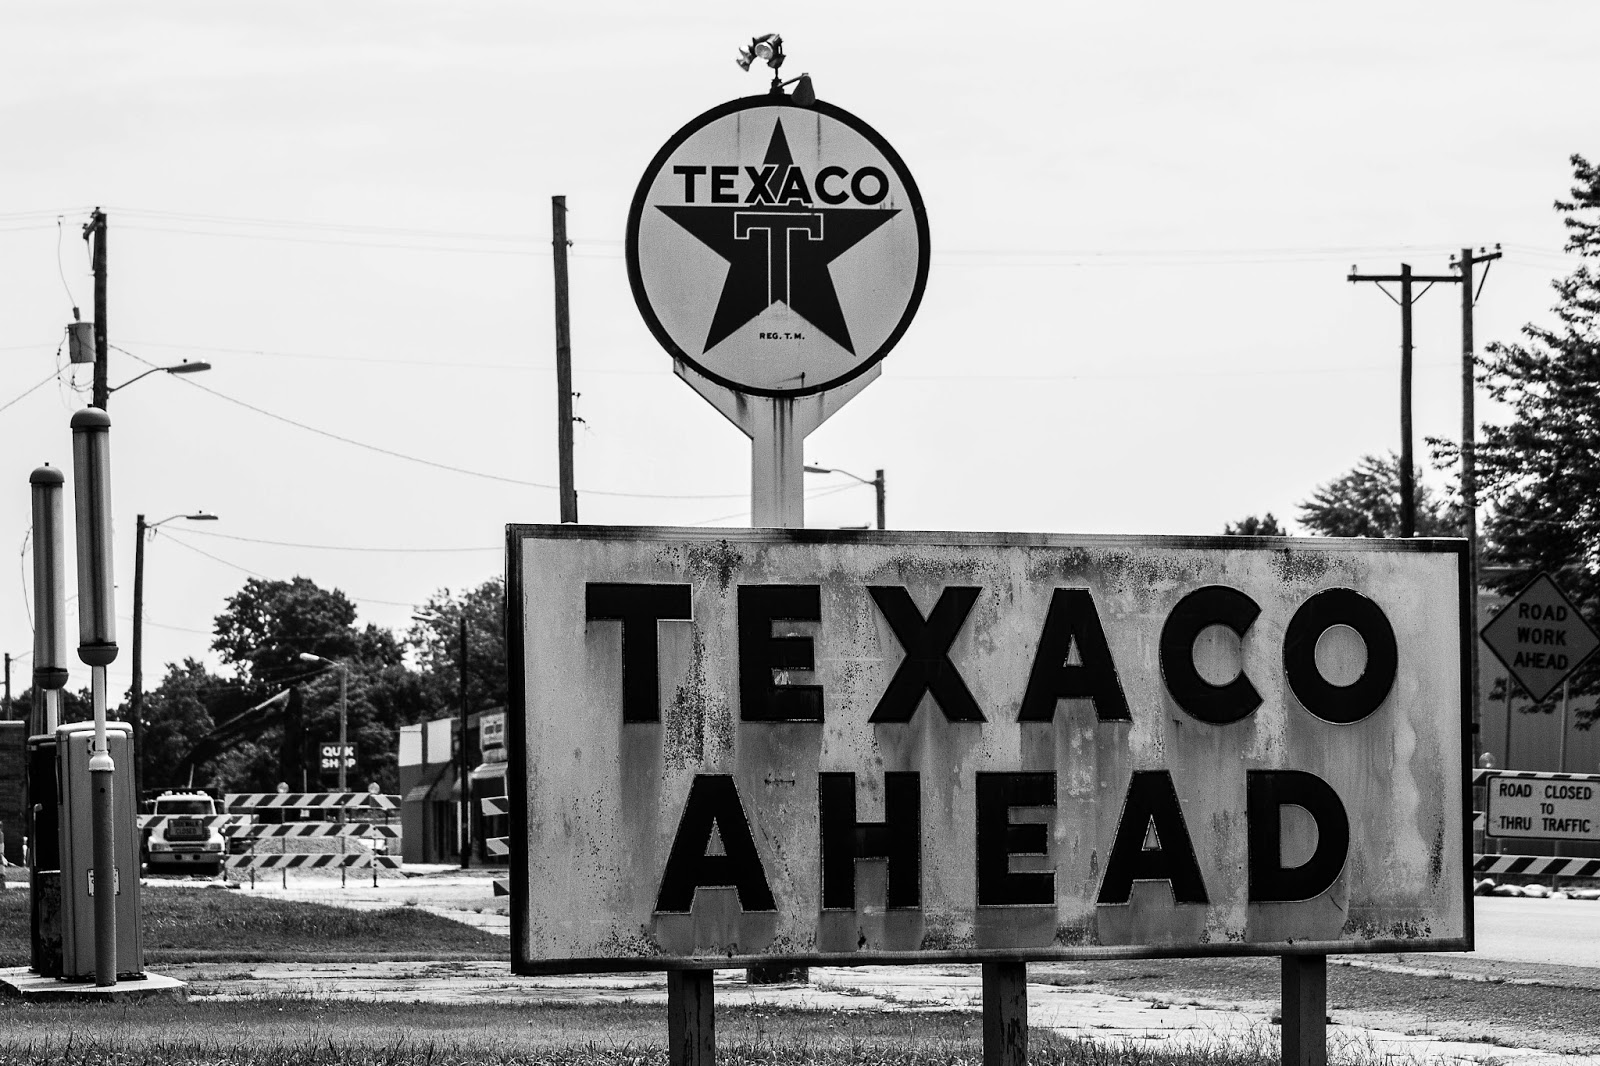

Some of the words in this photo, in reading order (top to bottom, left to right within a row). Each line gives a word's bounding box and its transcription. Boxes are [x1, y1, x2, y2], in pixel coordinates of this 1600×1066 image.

[673, 165, 889, 205] TEXACO
[759, 332, 782, 340] REG.
[1518, 602, 1568, 622] ROAD
[1517, 627, 1567, 646] WORK
[585, 582, 1398, 725] TEXACO
[1513, 651, 1569, 670] AHEAD
[322, 746, 354, 757] QUK
[1499, 783, 1532, 798] ROAD
[1544, 784, 1592, 800] CLOSED
[1540, 802, 1554, 815] TO
[1499, 815, 1532, 831] THRU
[1542, 817, 1591, 833] TRAFFIC
[653, 769, 1350, 914] AHEAD
